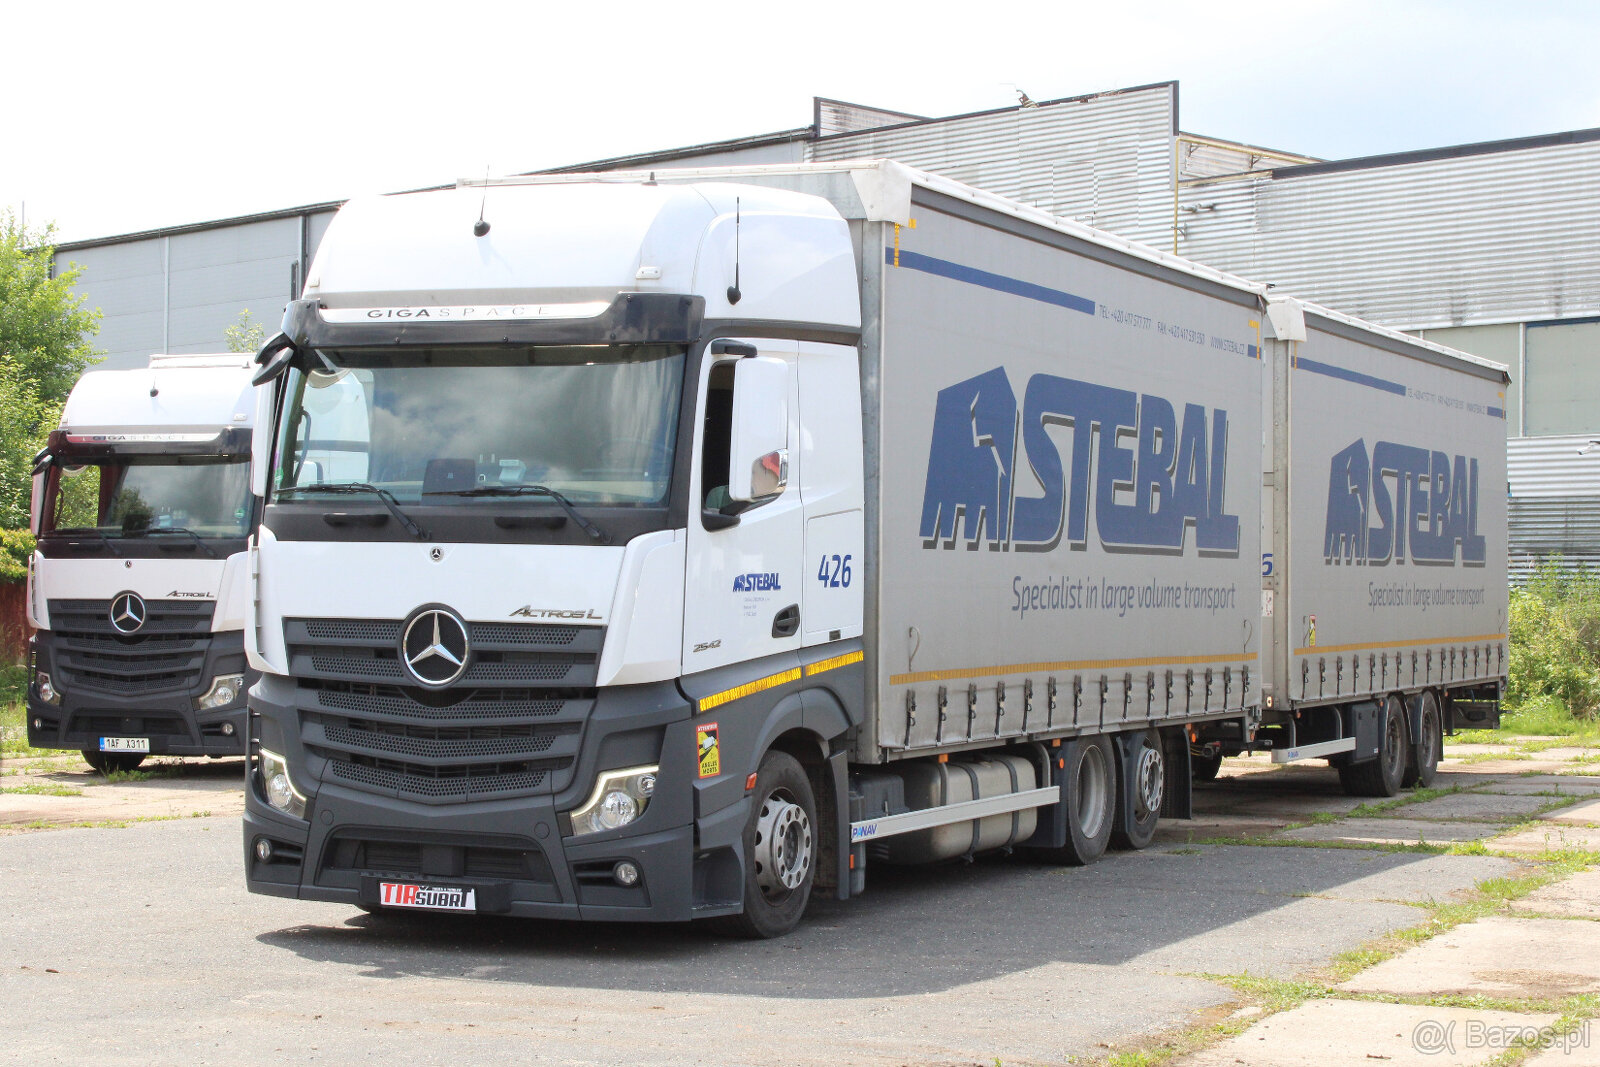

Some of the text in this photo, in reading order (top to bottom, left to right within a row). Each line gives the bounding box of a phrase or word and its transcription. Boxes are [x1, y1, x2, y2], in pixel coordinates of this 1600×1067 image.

[1011, 373, 1240, 559] STEBAL
[1367, 441, 1486, 568] STEBAL
[745, 573, 781, 591] STEBAL
[818, 554, 852, 588] 426
[1012, 576, 1083, 620] Specialist
[1085, 576, 1098, 609] in
[1102, 577, 1135, 618] large
[1138, 578, 1182, 609] volume
[1184, 581, 1236, 616] transport
[1368, 581, 1485, 612] Specialist in large volume transport
[693, 639, 721, 652] 2542
[106, 739, 119, 748] 1AF
[126, 739, 145, 749] X311
[852, 824, 877, 838] PANAV
[383, 883, 419, 905] TIR
